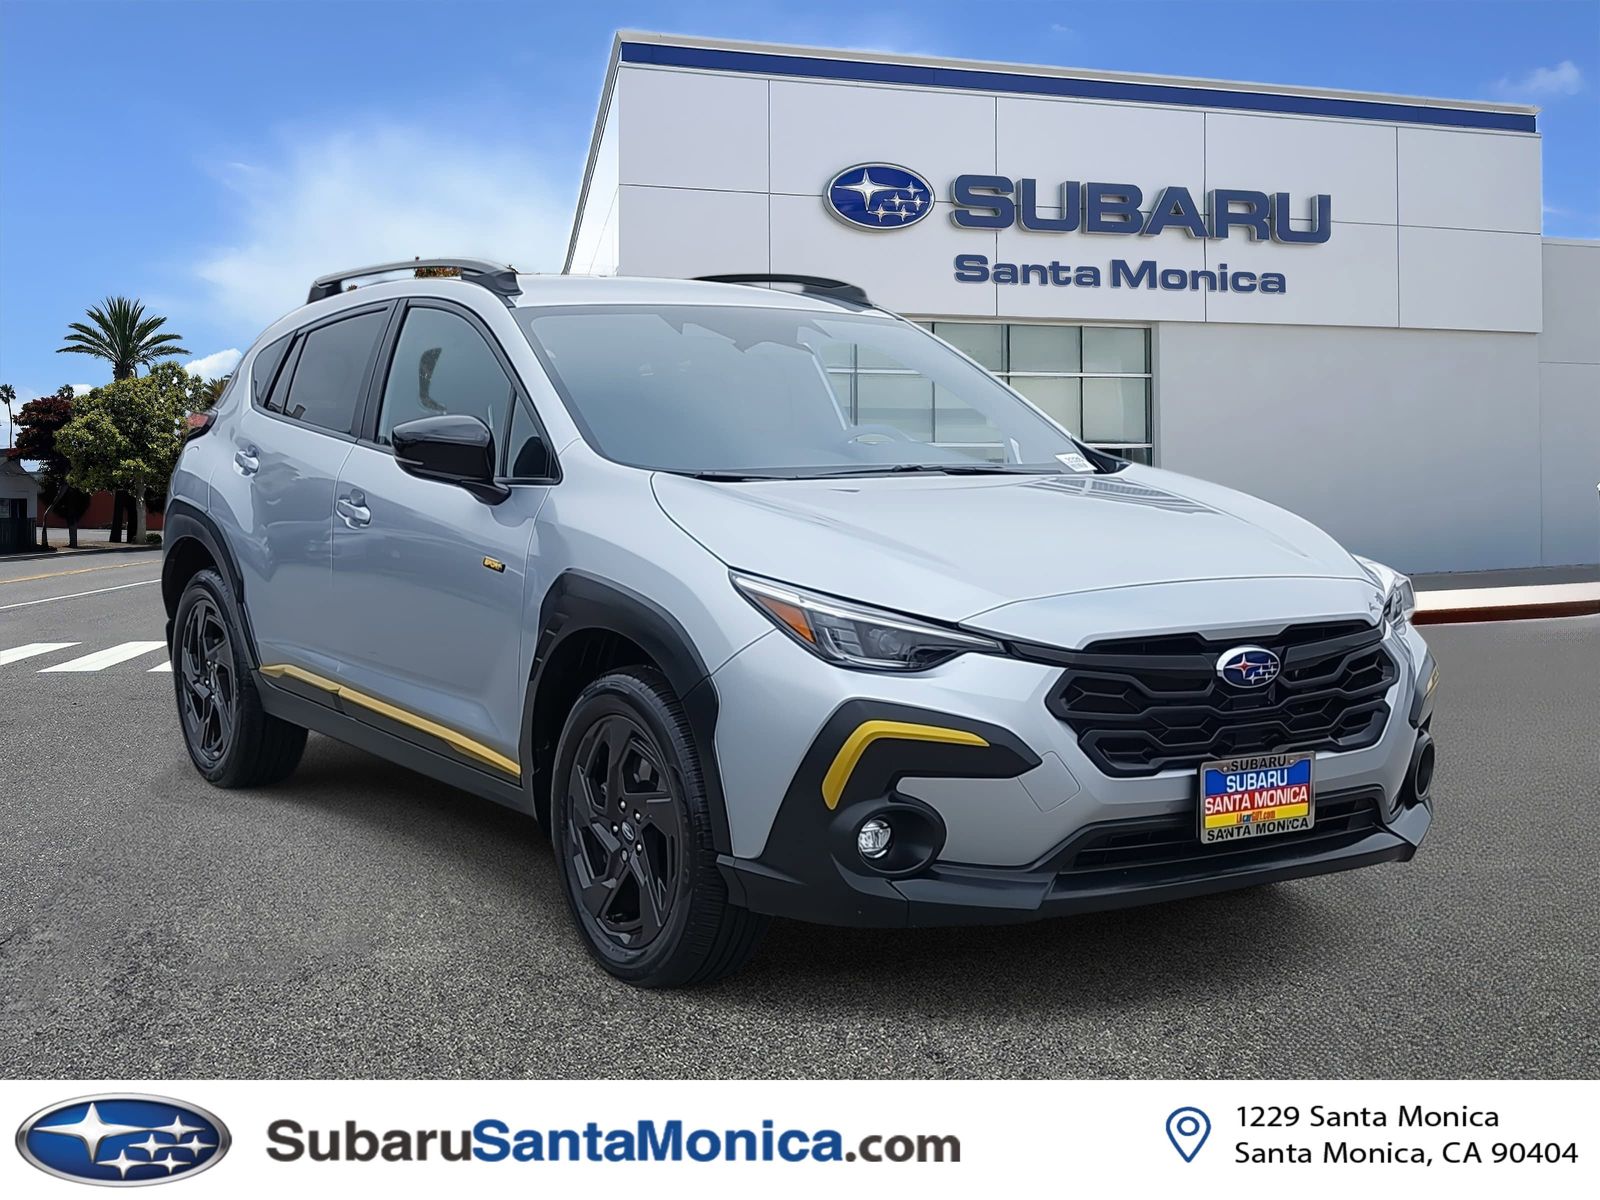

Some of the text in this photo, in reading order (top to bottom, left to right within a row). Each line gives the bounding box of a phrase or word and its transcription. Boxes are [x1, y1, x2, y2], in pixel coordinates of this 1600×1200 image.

[951, 174, 1331, 244] SUBARU
[954, 254, 1287, 294] Santa Monica
[1231, 755, 1287, 772] SUBARU
[1226, 769, 1288, 793] SUBARU
[1205, 786, 1308, 814] SANTA MONICA
[1207, 817, 1309, 841] SANTA MONICA
